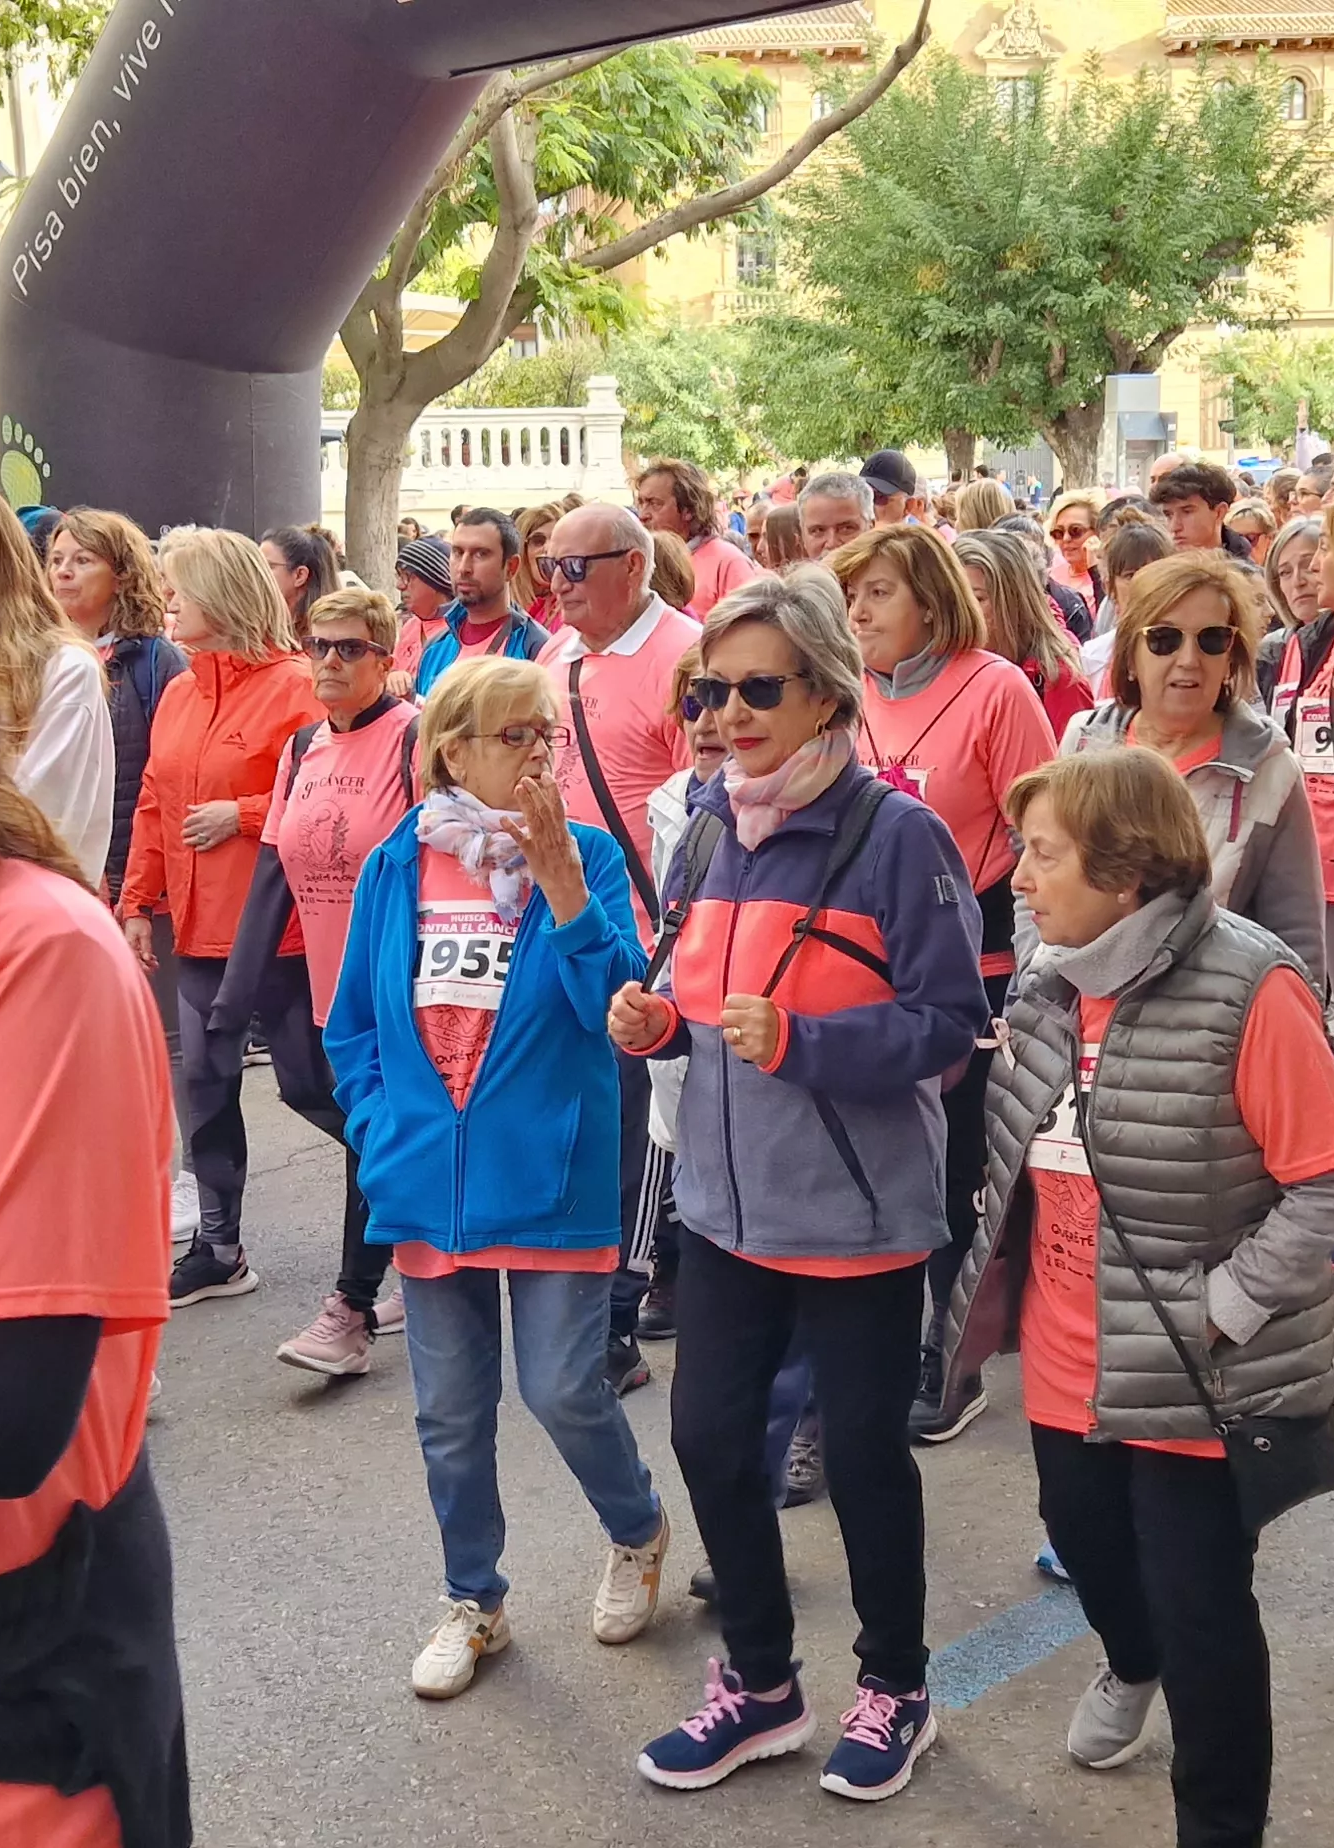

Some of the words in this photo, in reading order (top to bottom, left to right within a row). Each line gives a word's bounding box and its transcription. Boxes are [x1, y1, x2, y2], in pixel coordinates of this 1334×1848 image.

[12, 210, 65, 296] Pisa
[57, 119, 121, 209] bien,
[112, 20, 161, 101] vive
[417, 923, 458, 933] ONTRA
[461, 924, 475, 933] EL
[477, 919, 517, 935] CÁNC
[450, 913, 486, 922] HUESCA
[413, 939, 514, 981] 1955
